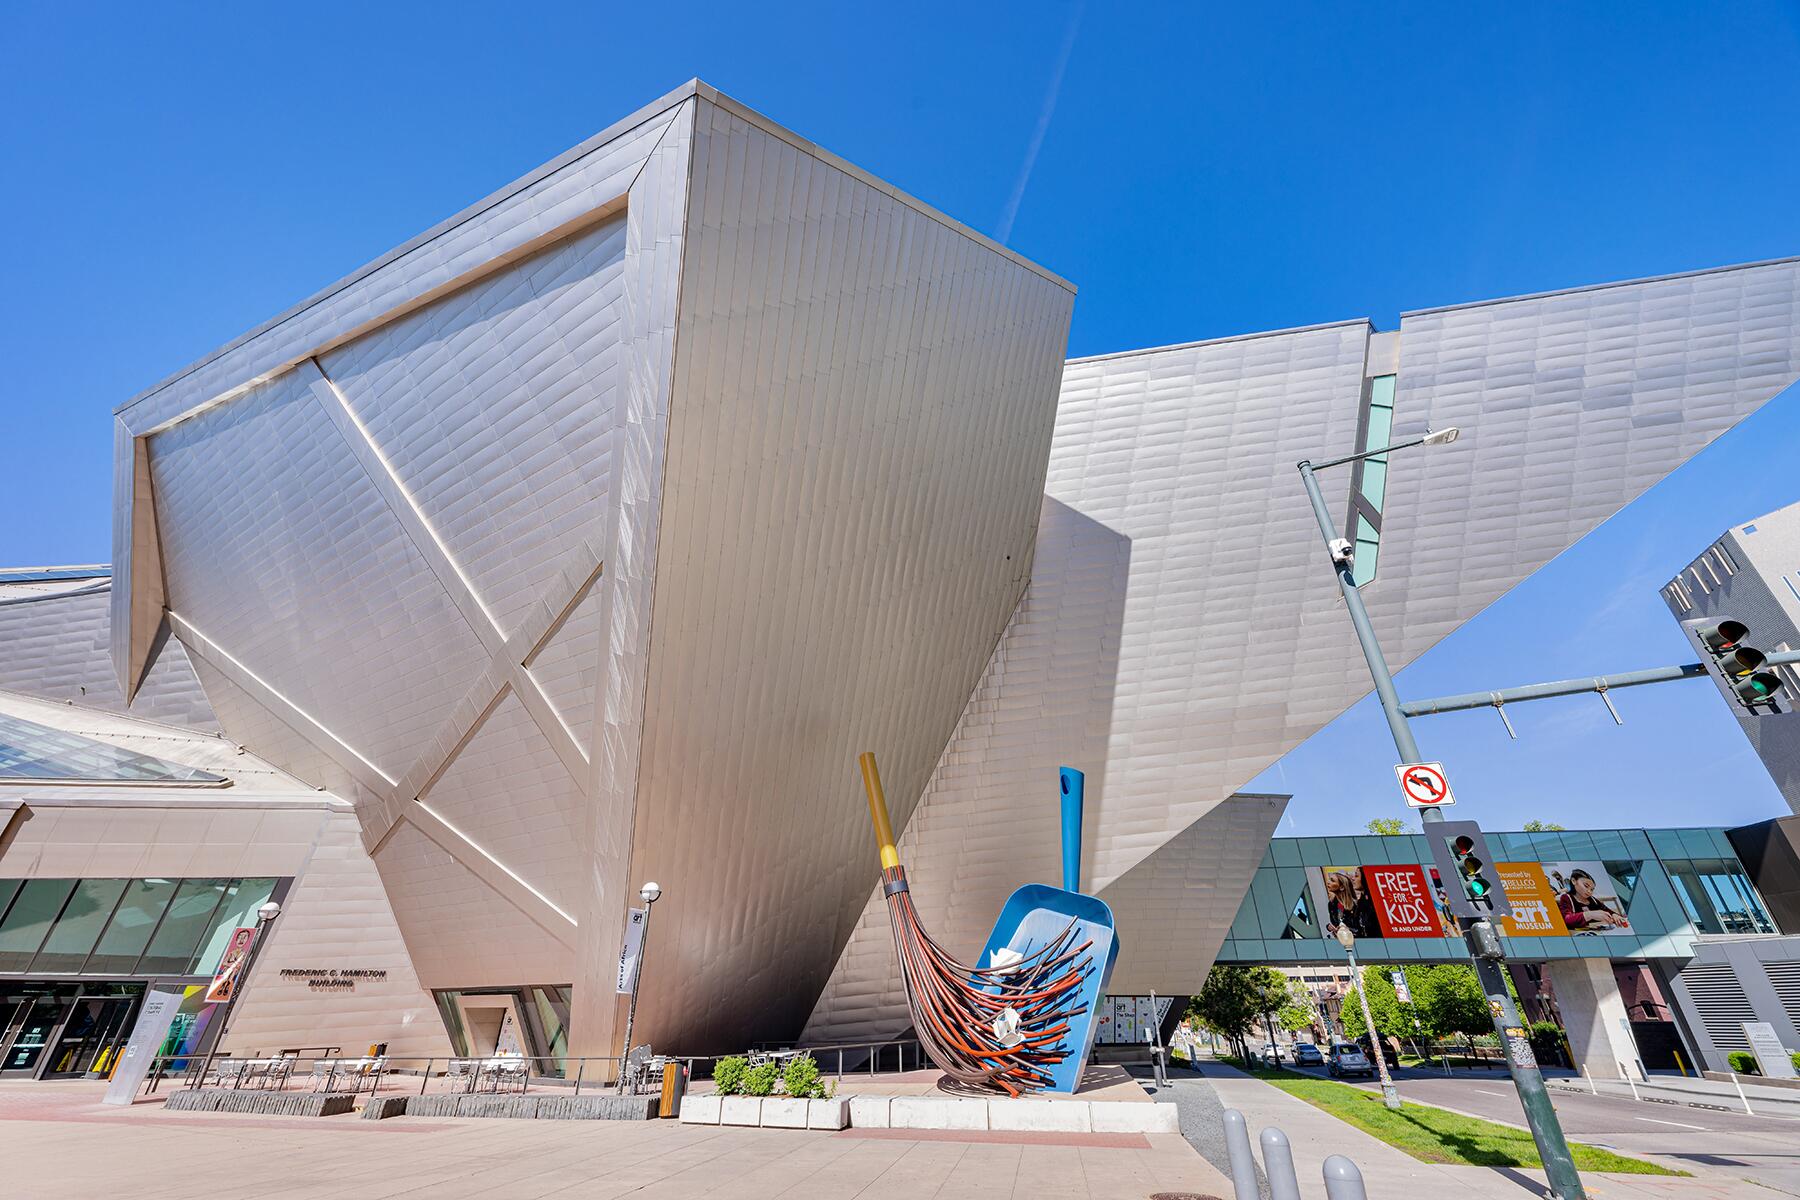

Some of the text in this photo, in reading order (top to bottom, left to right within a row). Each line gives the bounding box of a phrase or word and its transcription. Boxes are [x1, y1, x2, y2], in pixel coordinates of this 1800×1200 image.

[1374, 872, 1422, 898] FREE
[1507, 879, 1536, 887] BELLCO
[1393, 893, 1408, 903] FOR
[1383, 898, 1430, 925] KIDS
[1511, 899, 1550, 923] art
[1516, 922, 1554, 930] MUSEUM
[279, 969, 387, 978] FREDERIC C. HAMILTON
[308, 979, 354, 987] BUILDING
